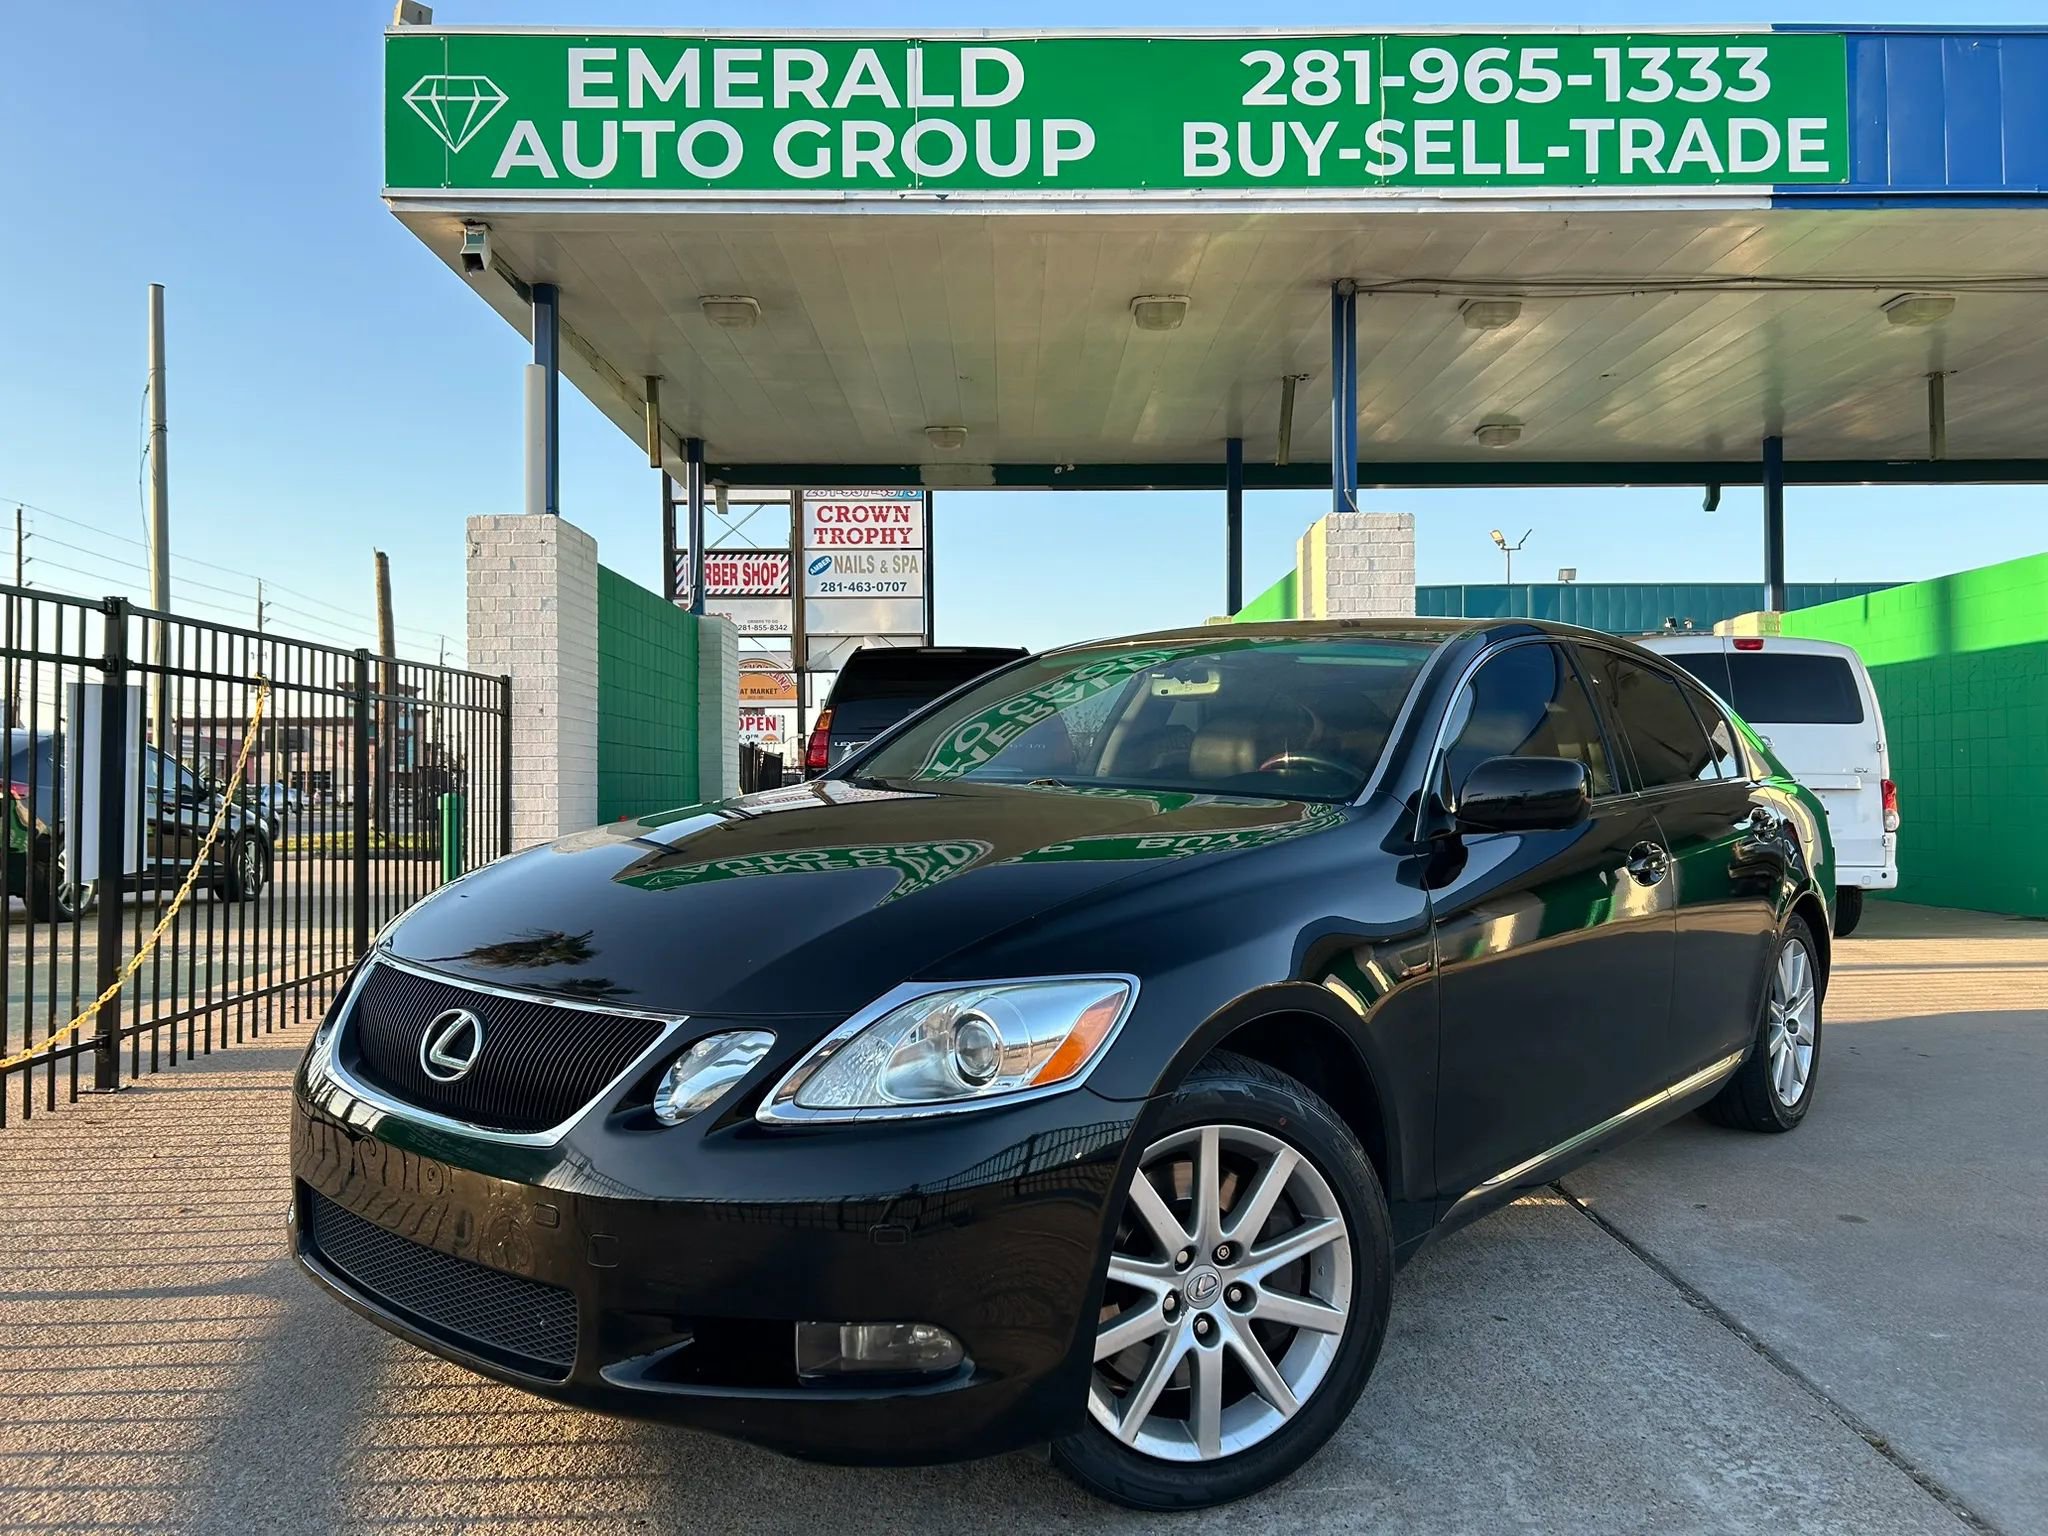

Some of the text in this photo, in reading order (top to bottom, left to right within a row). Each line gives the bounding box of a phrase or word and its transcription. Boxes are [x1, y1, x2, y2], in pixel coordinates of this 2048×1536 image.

[567, 47, 1025, 109] EMERALD
[1240, 46, 1771, 107] 281-965-1333
[490, 118, 1096, 180] AUTO GROUP
[1182, 116, 1829, 178] BUY-SELL-TRADE
[816, 505, 911, 523] CROWN
[813, 527, 913, 545] TROPHY
[686, 562, 779, 586] RBER SHOP
[834, 555, 919, 574] NAILS & SPA
[820, 582, 908, 592] 281-463-0707
